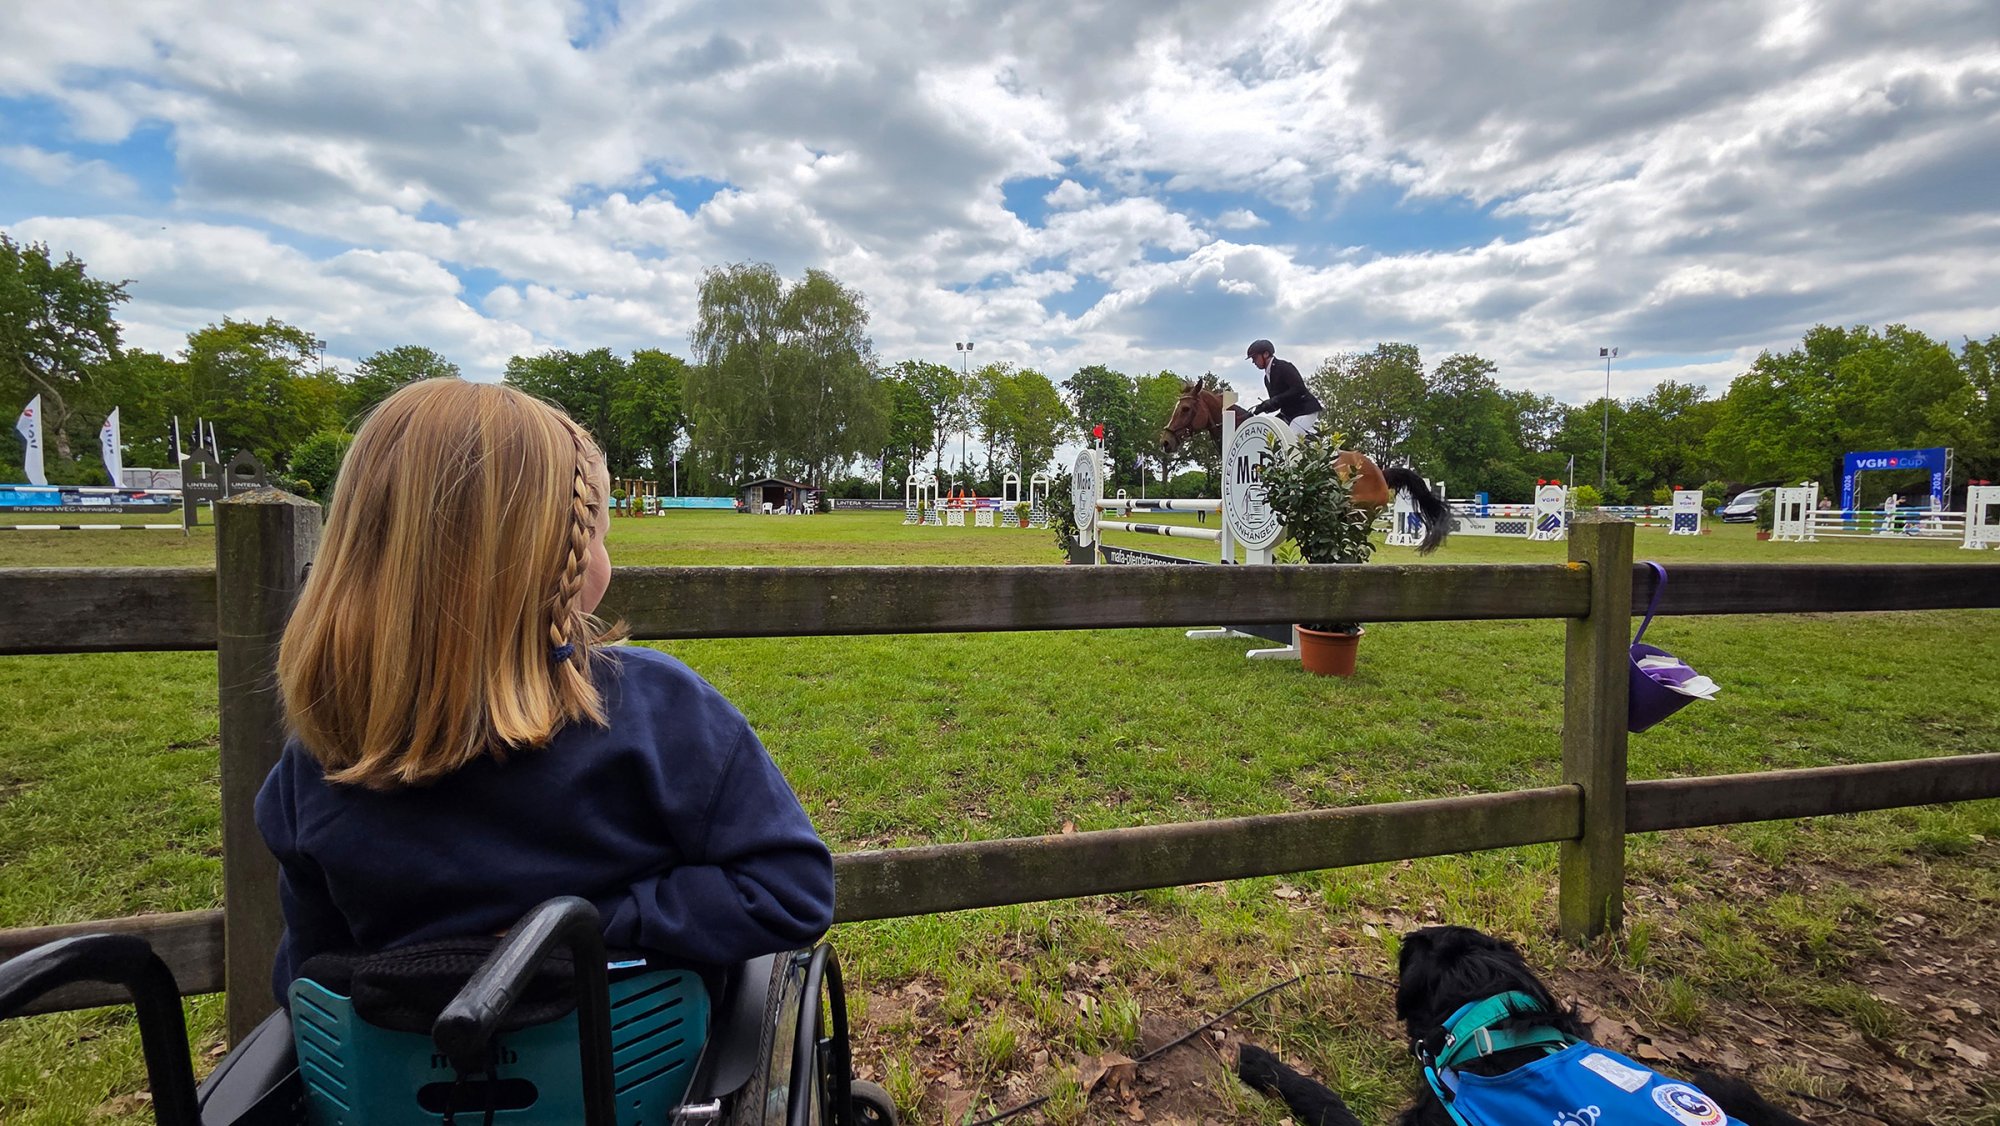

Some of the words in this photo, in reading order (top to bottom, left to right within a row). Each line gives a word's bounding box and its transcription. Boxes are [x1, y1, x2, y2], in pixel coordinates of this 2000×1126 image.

[1856, 458, 1887, 468] VGH
[1899, 457, 1923, 467] Cup
[1234, 519, 1276, 540] ANHÄNGER
[1400, 535, 1405, 544] A
